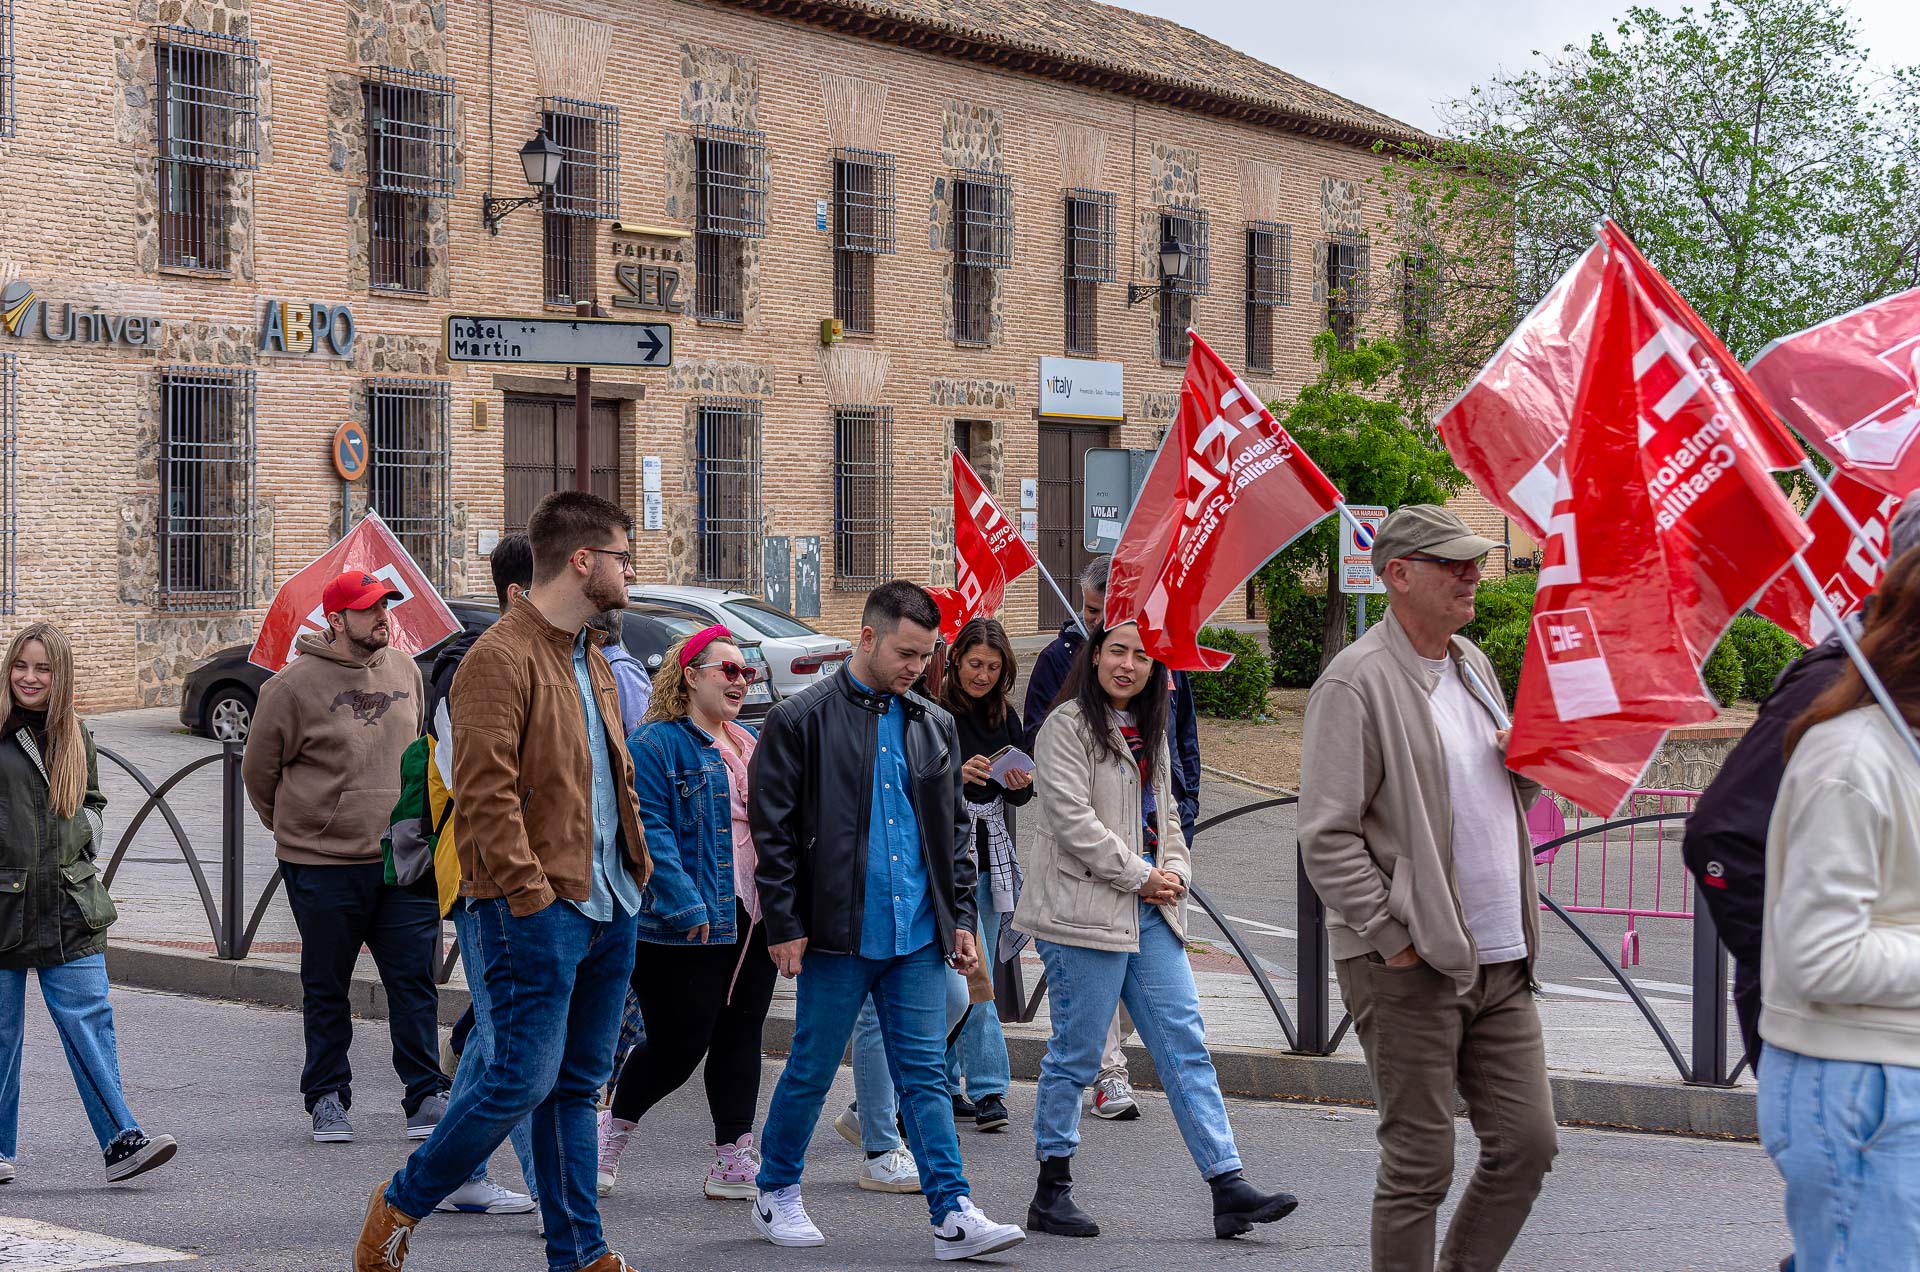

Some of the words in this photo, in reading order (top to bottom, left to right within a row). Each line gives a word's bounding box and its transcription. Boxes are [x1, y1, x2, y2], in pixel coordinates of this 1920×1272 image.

[612, 261, 685, 313] SER
[261, 299, 355, 355] ABPO
[454, 323, 503, 339] hotel
[454, 339, 521, 357] Martín
[1047, 375, 1073, 399] vitaly
[352, 694, 386, 711] Ford
